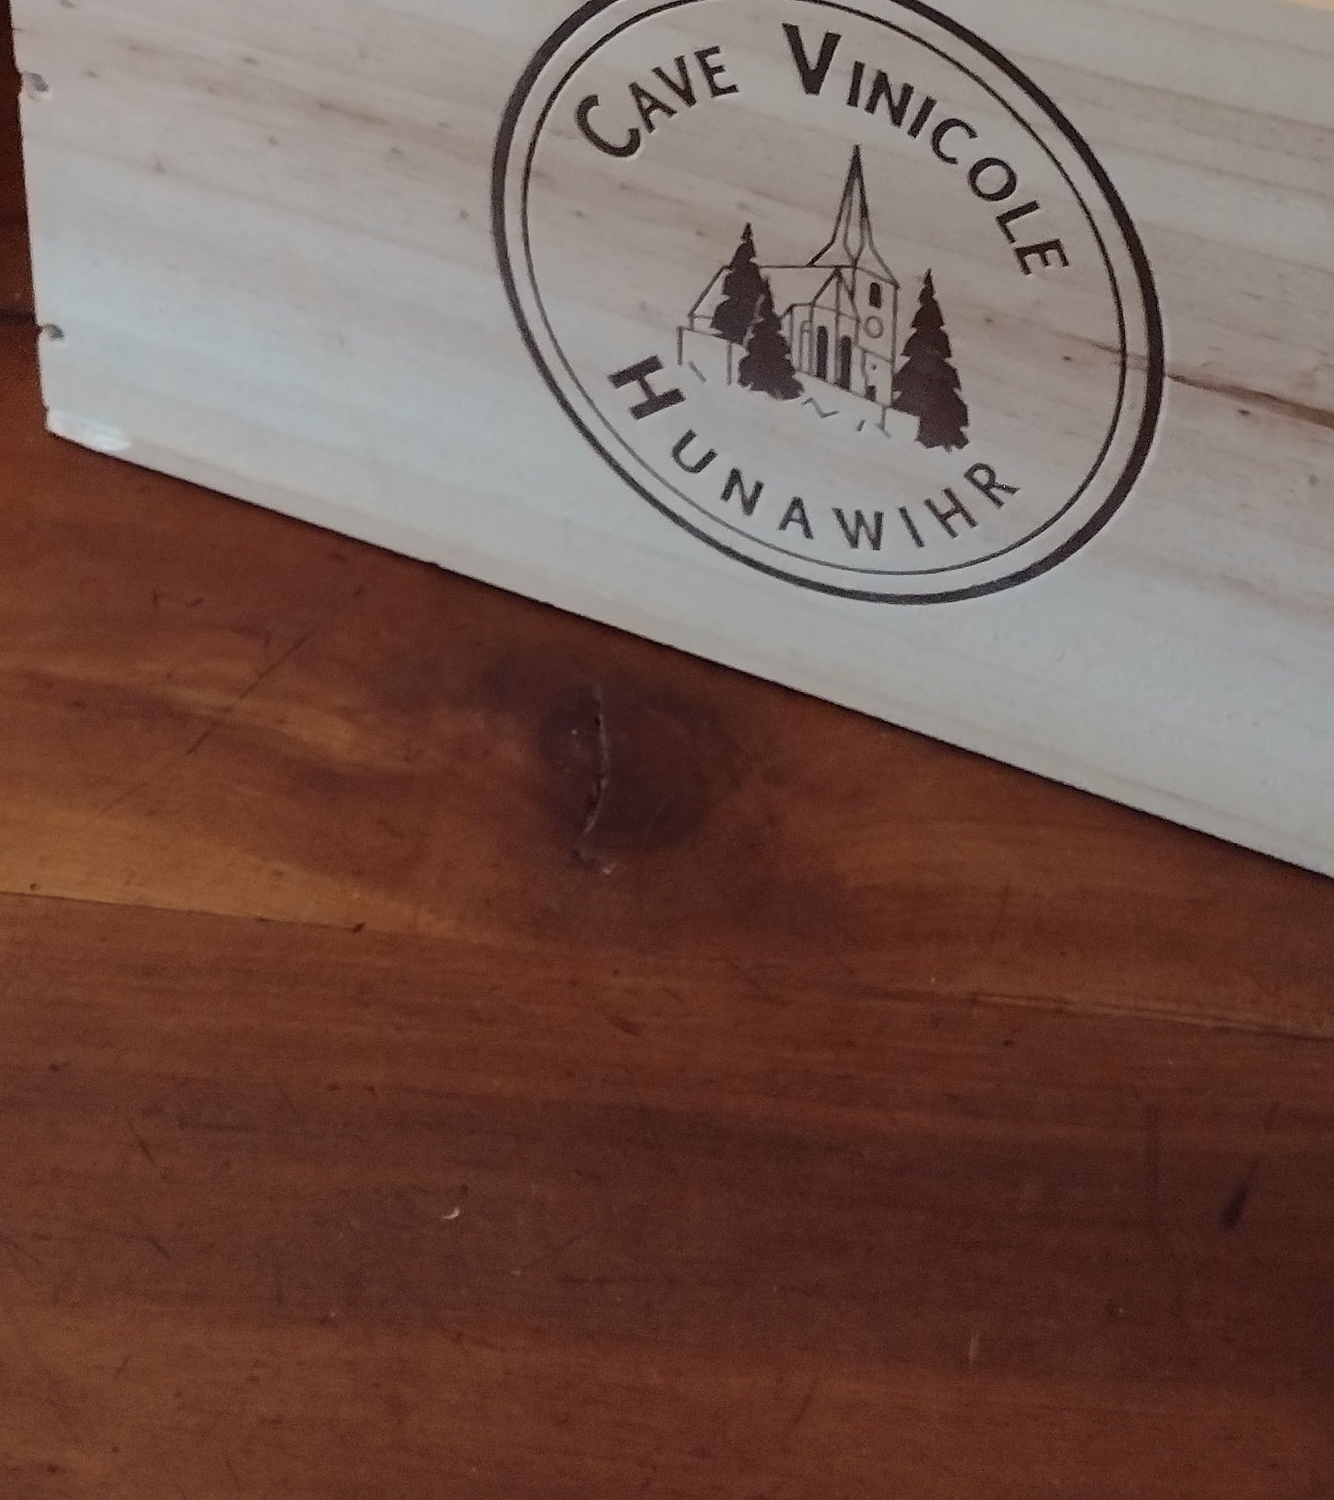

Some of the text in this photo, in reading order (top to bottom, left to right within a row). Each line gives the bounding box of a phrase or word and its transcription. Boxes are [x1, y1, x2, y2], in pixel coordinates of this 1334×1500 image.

[574, 21, 1071, 277] CAVE VINICOLE
[606, 355, 1021, 551] HUNAWIHR
